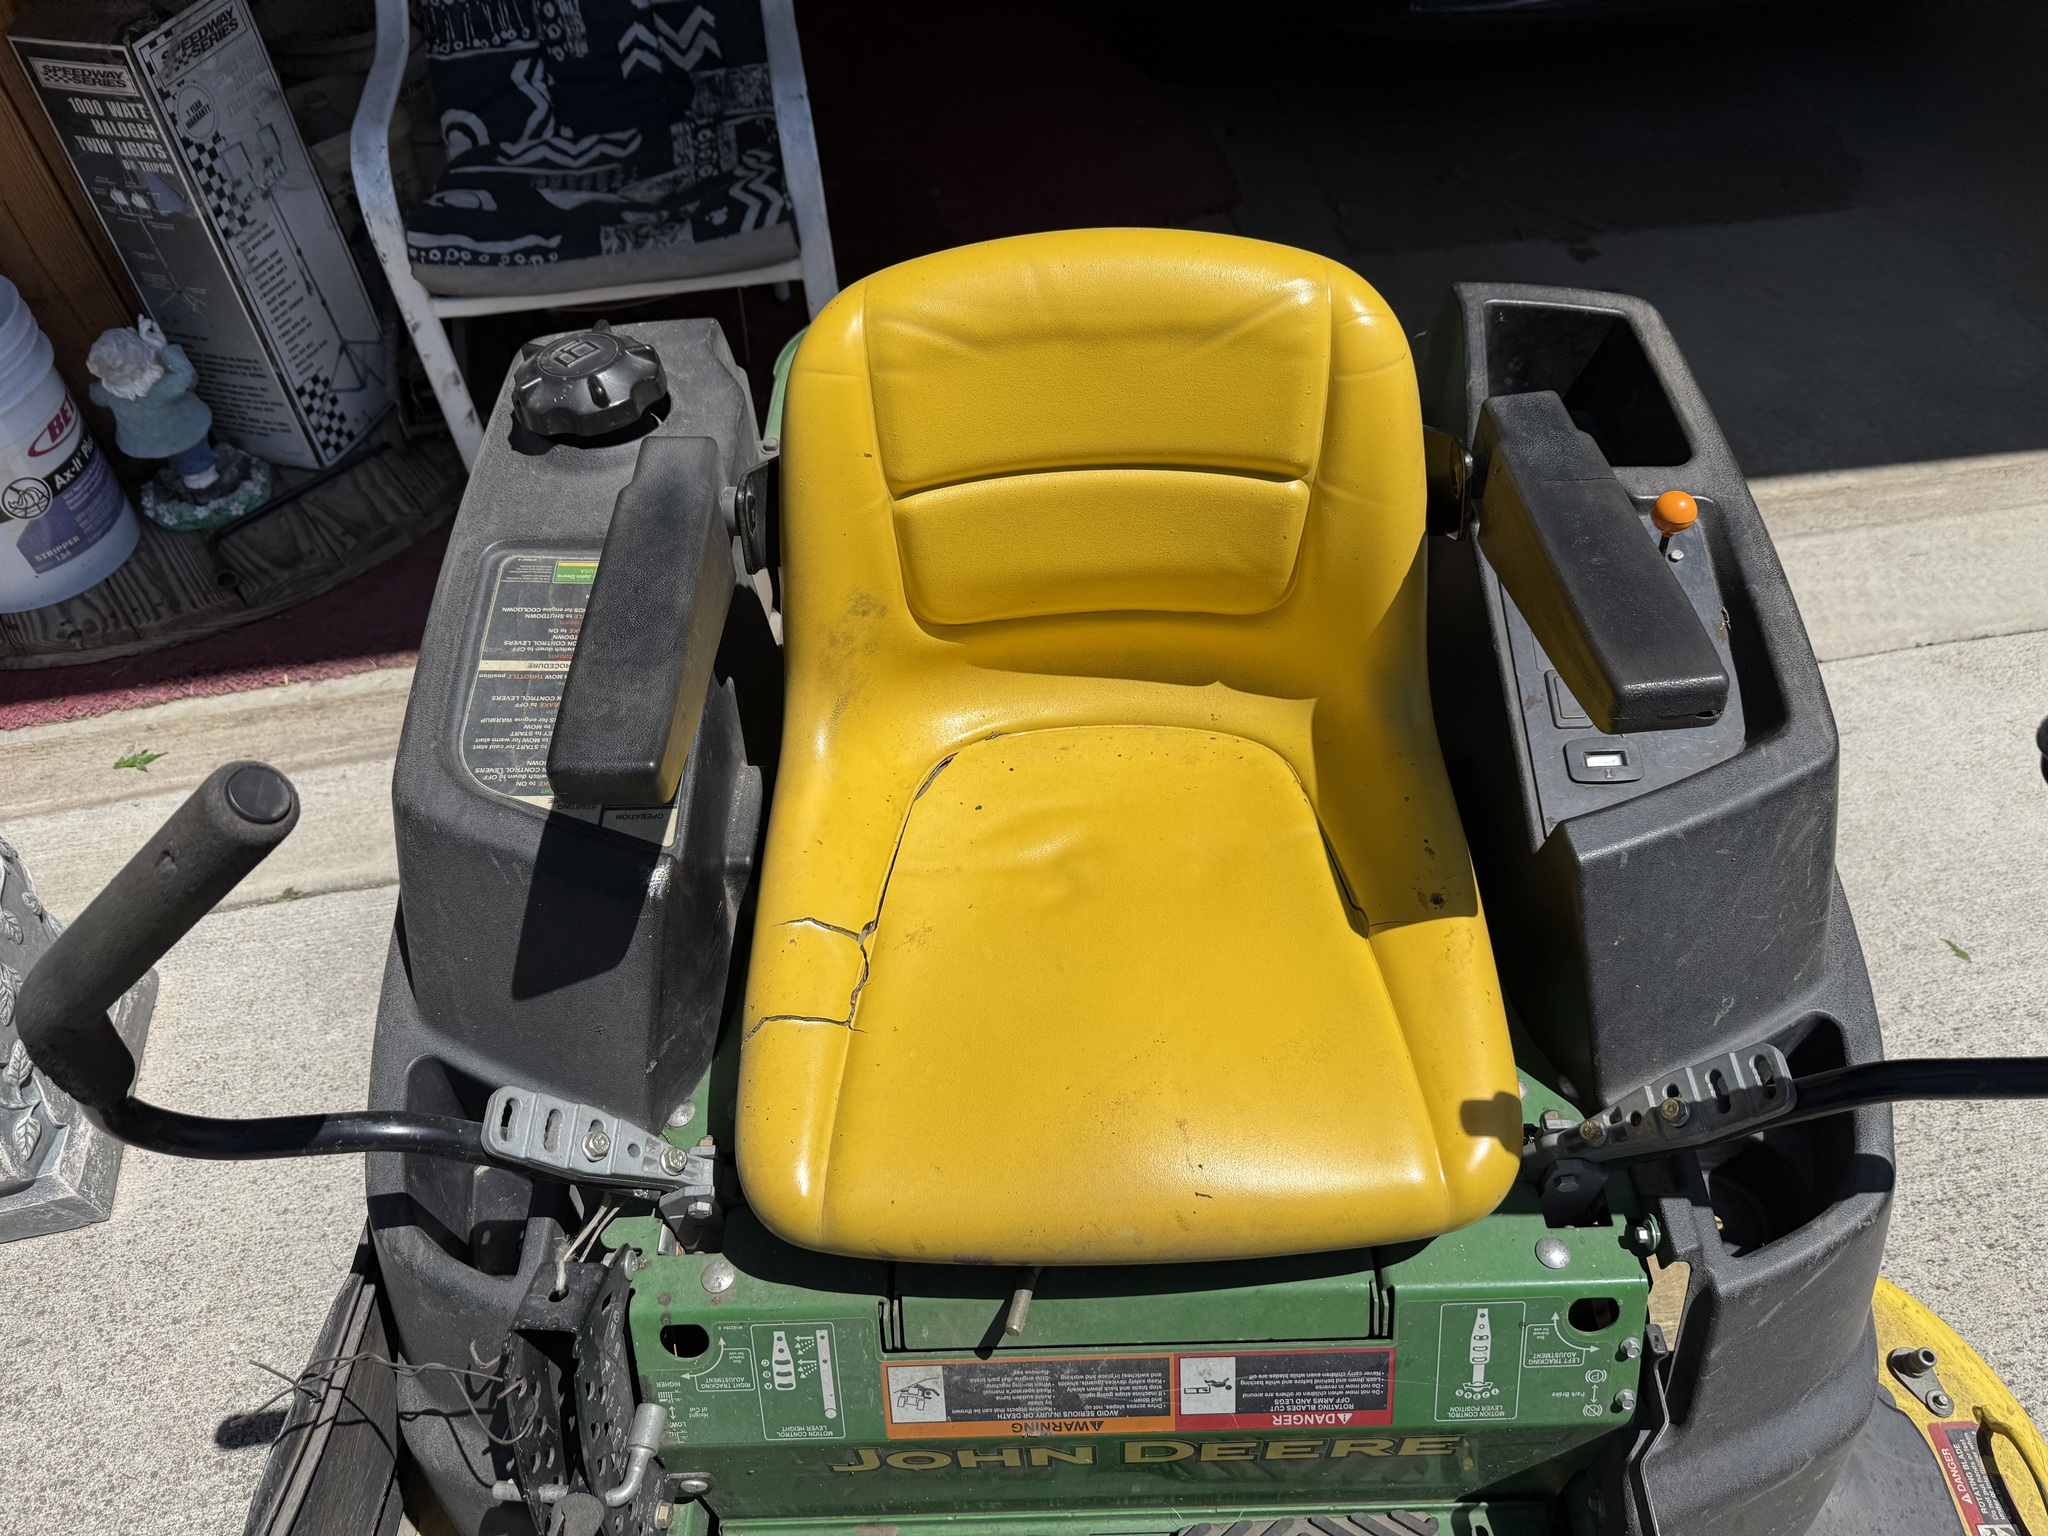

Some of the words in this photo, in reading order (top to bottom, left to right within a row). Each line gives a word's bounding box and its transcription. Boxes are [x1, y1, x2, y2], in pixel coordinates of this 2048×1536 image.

[191, 18, 238, 57] SERIES
[42, 65, 123, 79] SPEEDWAY
[72, 78, 126, 88] SERIES
[68, 97, 104, 116] 1000
[105, 101, 148, 119] WATT
[190, 100, 203, 113] YEAR
[185, 104, 211, 130] WARRANTY
[91, 119, 158, 139] HALOGEN
[74, 135, 113, 155] TWIN
[115, 141, 167, 159] LIGHTS
[138, 161, 174, 174] TRIPOD
[34, 535, 80, 562] STRIPPER
[1012, 1421, 1089, 1433] WARNING
[1272, 1413, 1335, 1425] DANGER
[1960, 1439, 1968, 1451] feet
[1964, 1433, 1975, 1449] when
[829, 1447, 1096, 1472] JOHN
[1121, 1436, 1461, 1464] DEERE
[1953, 1444, 1969, 1469] BLADE
[1942, 1448, 1967, 1492] DANGER
[1971, 1464, 1982, 1483] hands
[1980, 1484, 1988, 1496] put
[1983, 1476, 1992, 1490] into
[1966, 1472, 1988, 1514] ROTATING
[1990, 1509, 1998, 1520] Do
[1993, 1501, 2005, 1520] under
